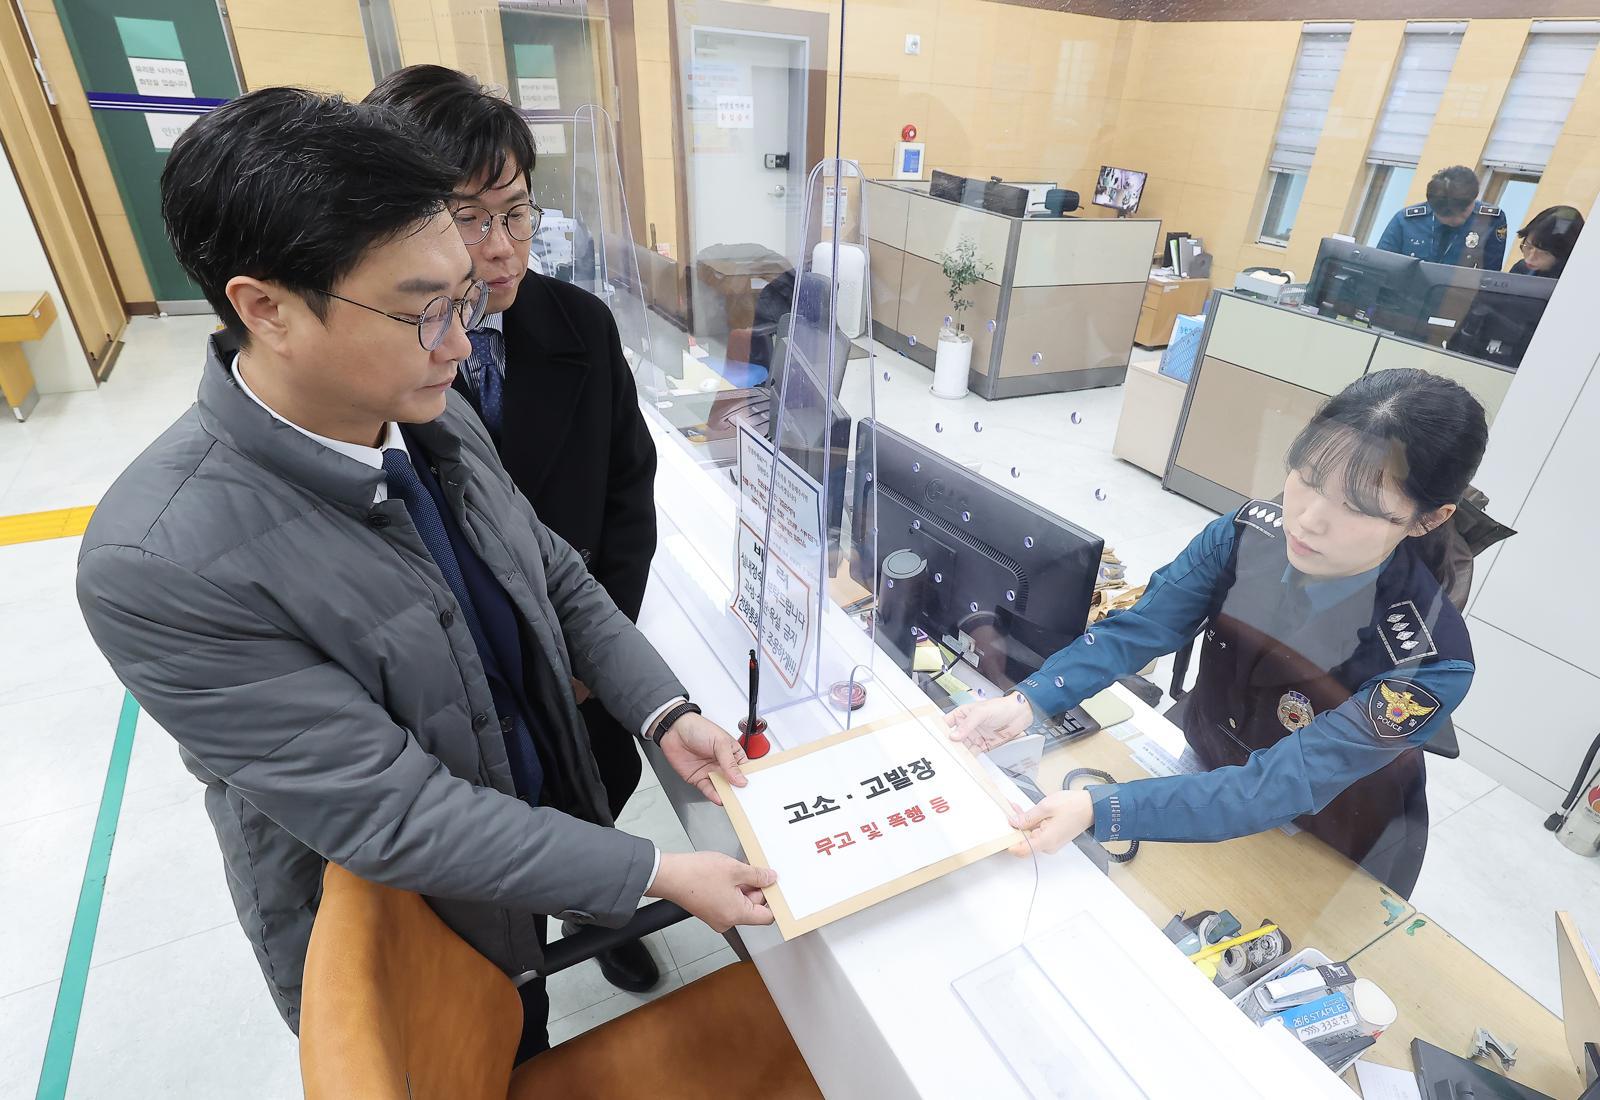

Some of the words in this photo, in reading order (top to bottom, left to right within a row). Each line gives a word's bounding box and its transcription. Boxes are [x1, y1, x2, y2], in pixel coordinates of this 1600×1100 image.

[767, 579, 806, 631] 부탁드립니다
[783, 623, 798, 649] 금지
[1376, 714, 1403, 733] POLICE
[784, 795, 841, 824] 고소
[860, 757, 936, 800] 고발장
[815, 831, 856, 856] 무고
[860, 821, 883, 841] 및
[886, 805, 926, 828] 폭행
[929, 796, 950, 814] 등
[1310, 1002, 1348, 1021] STAPLES
